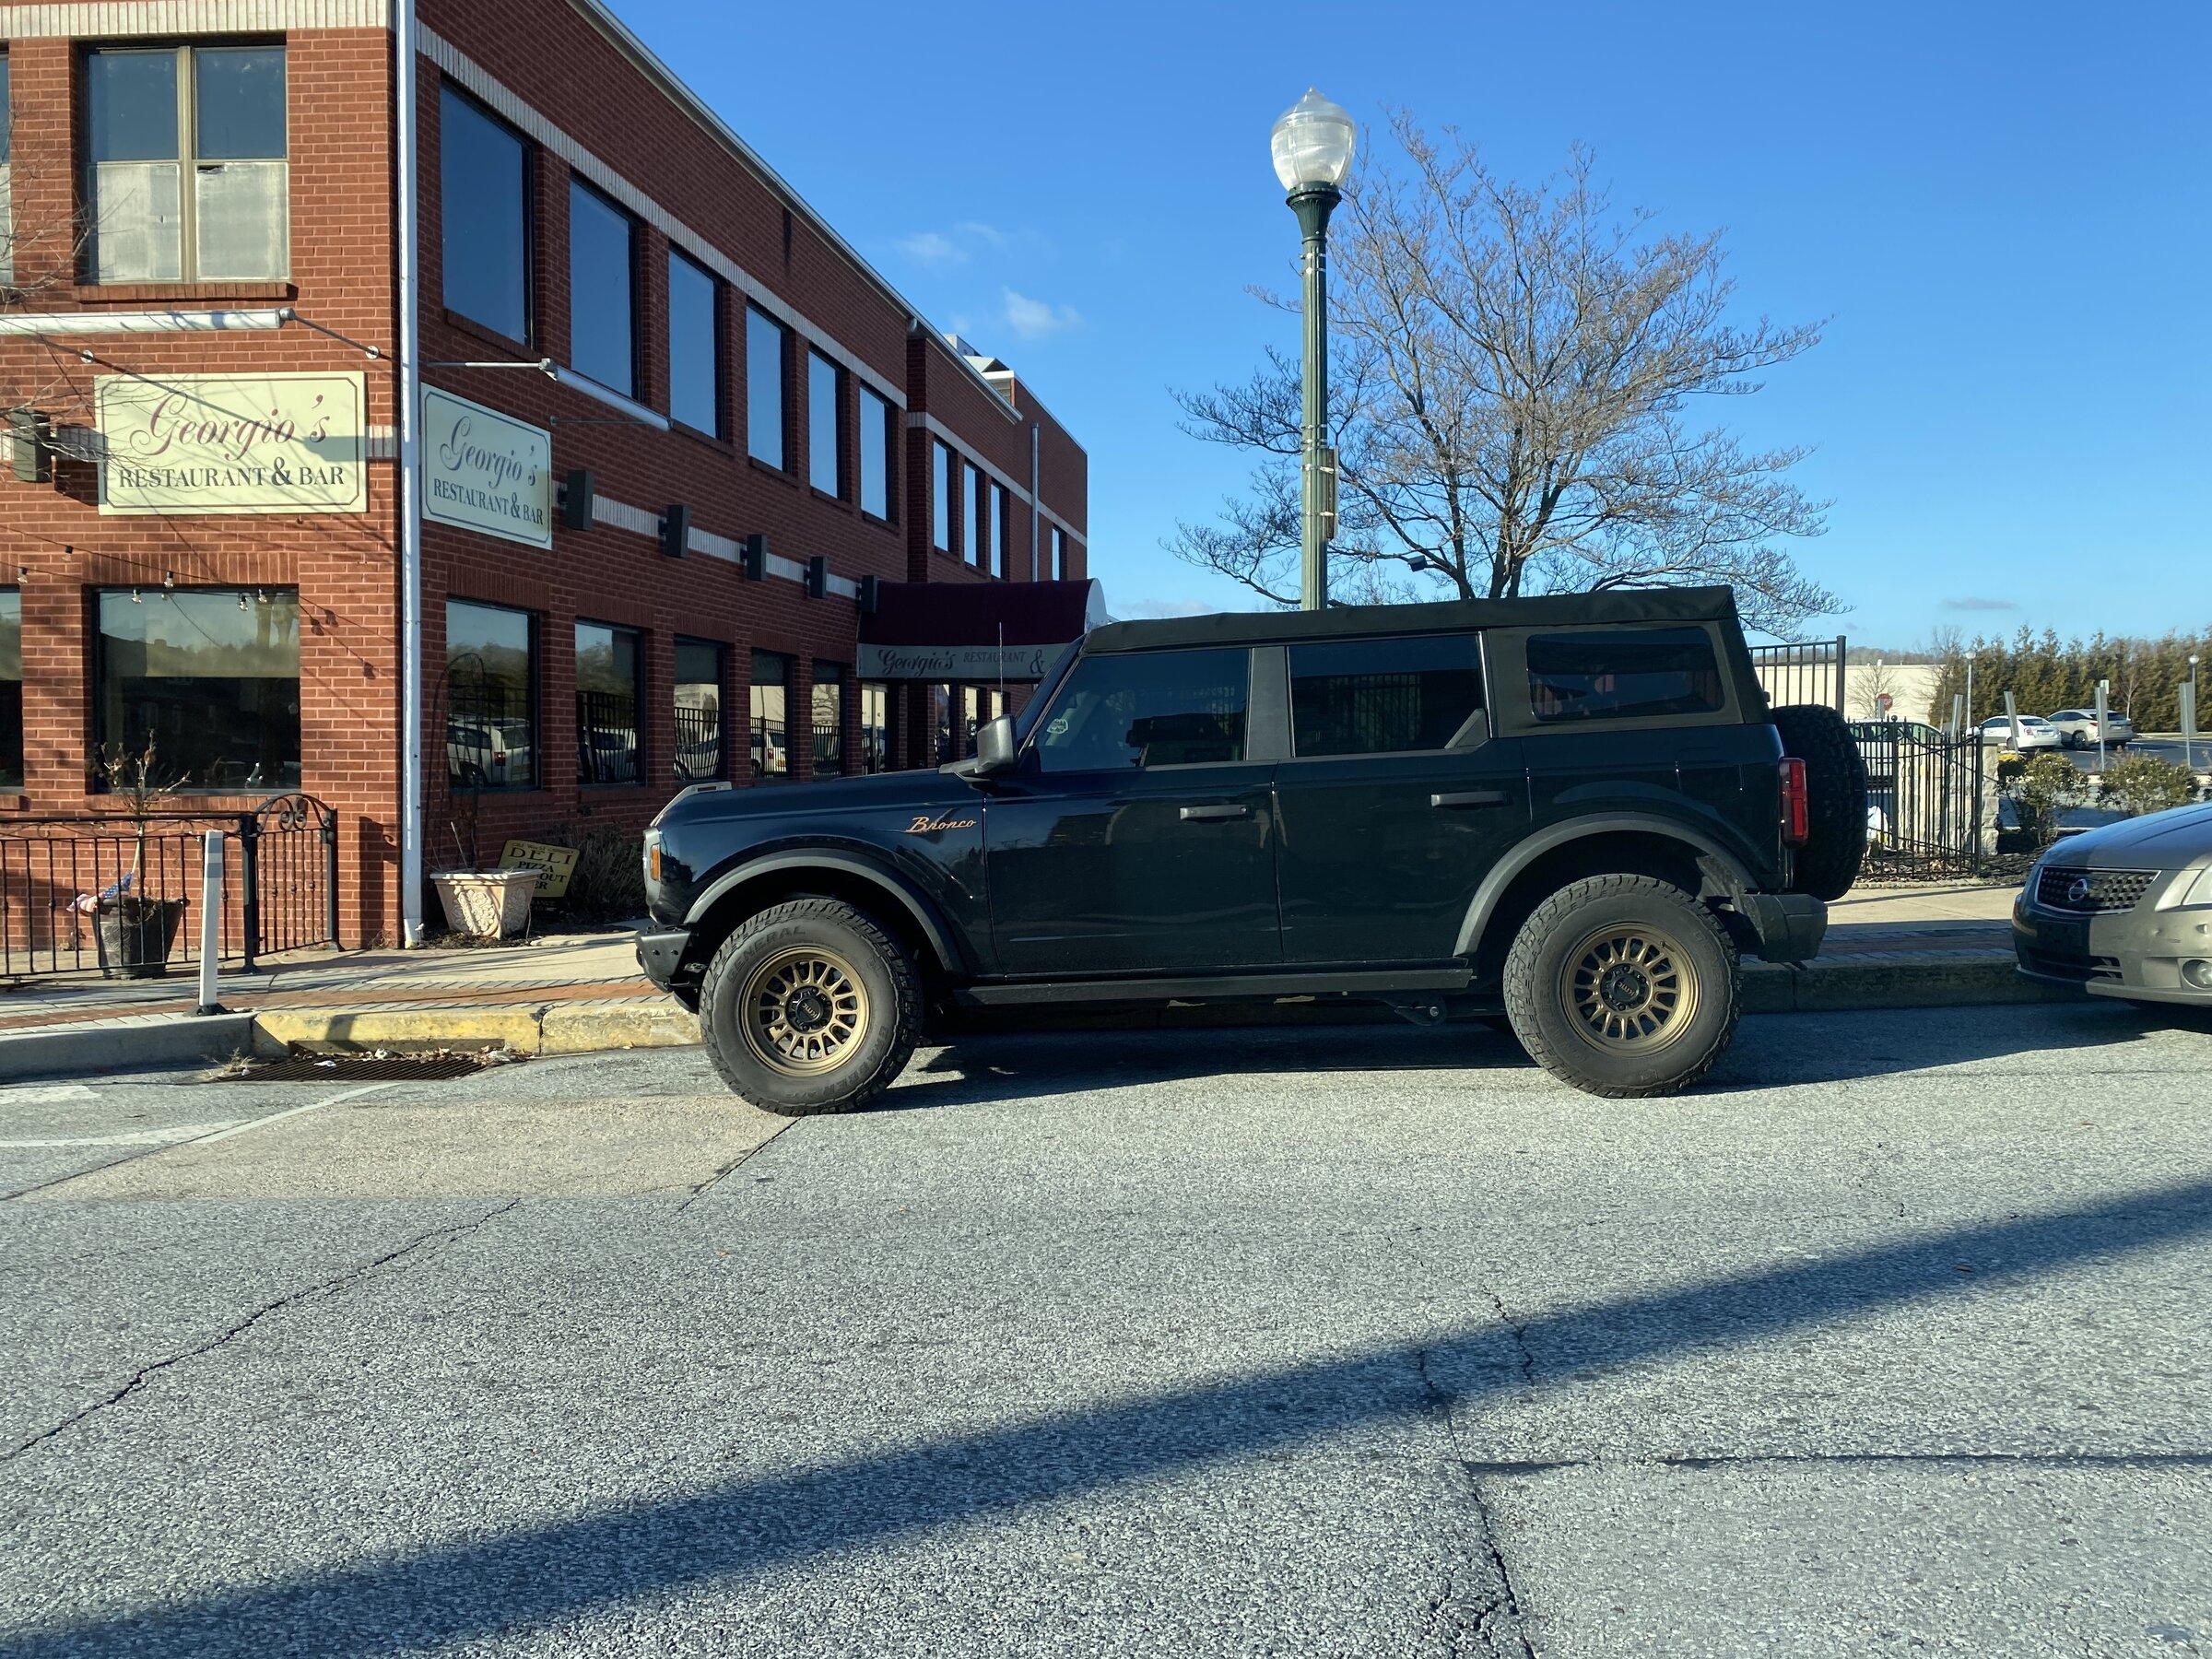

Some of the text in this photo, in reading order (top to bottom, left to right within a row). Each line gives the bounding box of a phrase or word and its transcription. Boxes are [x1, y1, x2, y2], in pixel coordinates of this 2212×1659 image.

[129, 391, 330, 462] Georgio's
[440, 416, 537, 489] Georgio's
[119, 456, 345, 488] RESTAURANT & BAR
[433, 478, 544, 526] RESTAURANT & BAR
[877, 649, 1045, 675] Georgio's RESTAURANT &
[903, 817, 977, 833] Bronco
[508, 847, 572, 865] DELI
[518, 861, 554, 873] PIZZA
[540, 873, 567, 882] OUT
[727, 925, 806, 983] GENERAL
